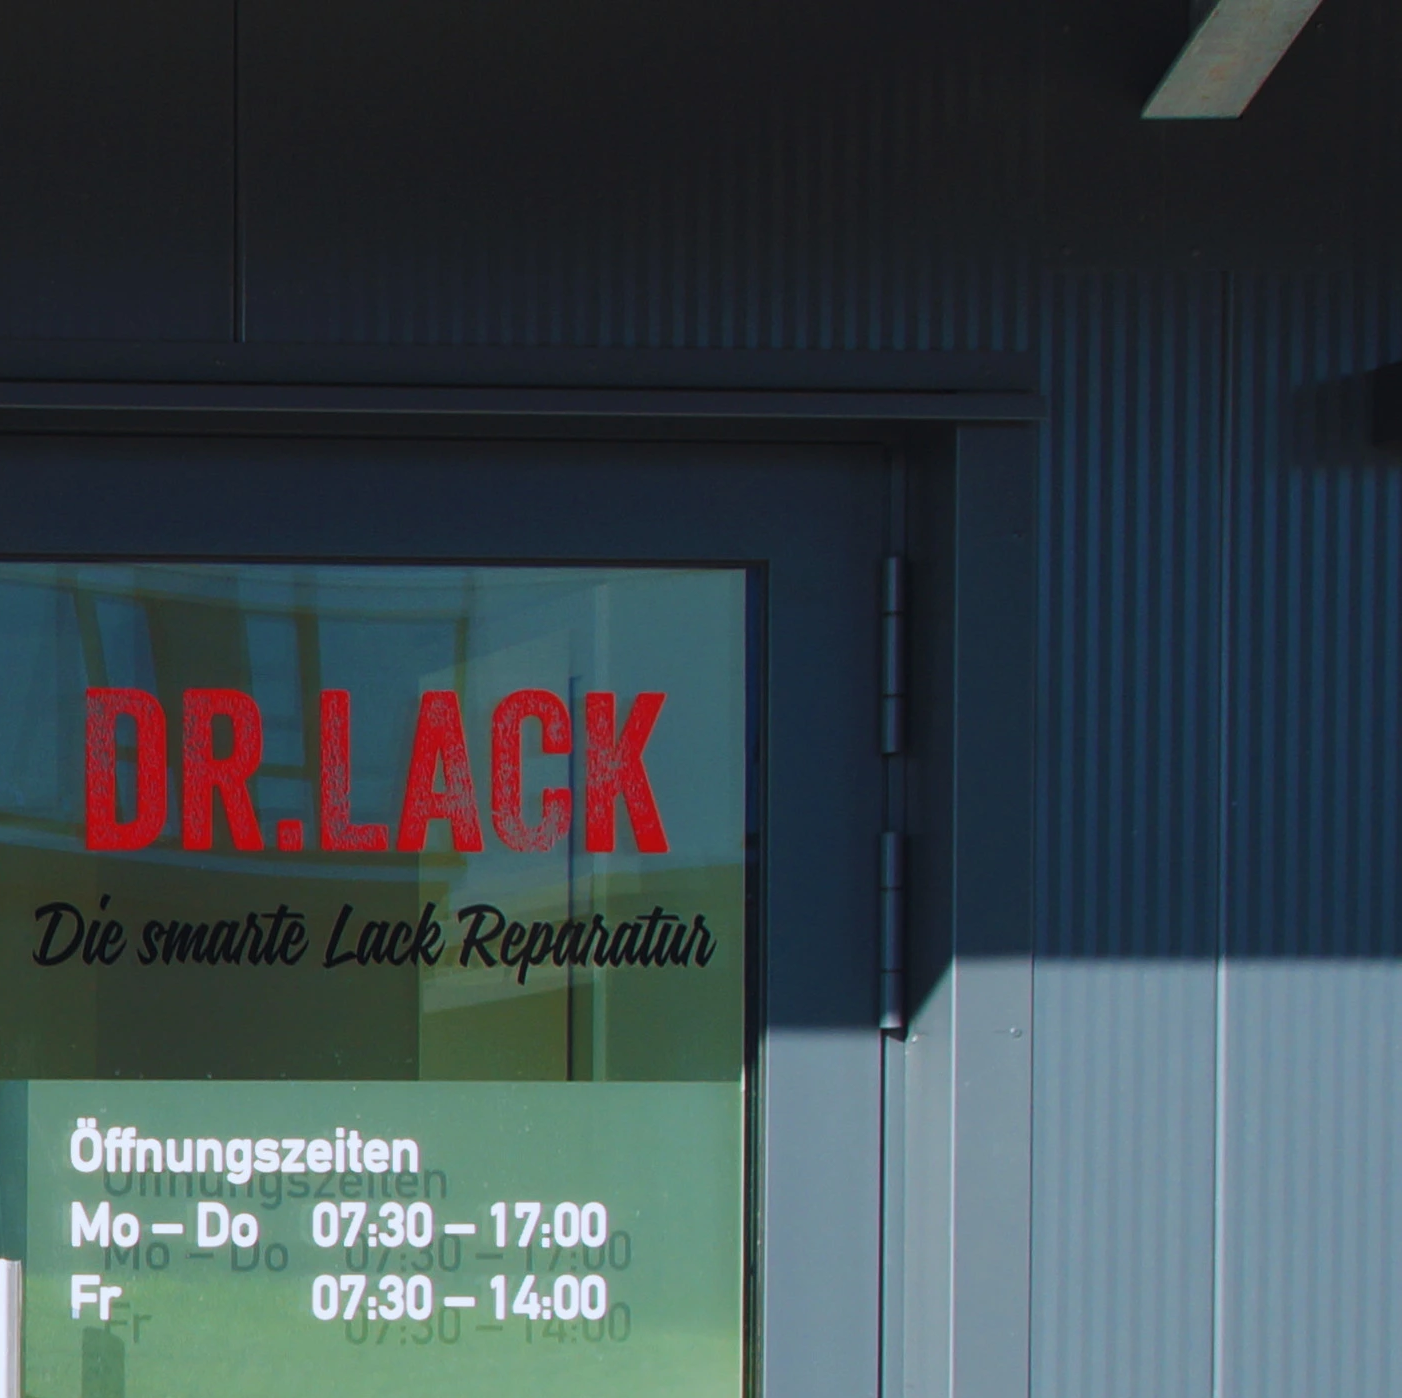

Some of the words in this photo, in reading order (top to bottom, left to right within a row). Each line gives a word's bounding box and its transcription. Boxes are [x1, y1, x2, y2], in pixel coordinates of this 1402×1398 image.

[85, 687, 670, 854] DR.LACK
[32, 893, 127, 966] Die
[137, 904, 310, 966] smarte
[322, 903, 446, 968] Lack
[457, 903, 718, 985] Reparatur
[70, 1117, 419, 1185] Öffnungszeiten
[70, 1201, 140, 1248] Mo
[196, 1201, 259, 1248] Do
[311, 1201, 433, 1248] 07:30
[489, 1201, 607, 1248] 17:00
[70, 1274, 122, 1320] Fr
[311, 1274, 433, 1321] 07:30
[489, 1274, 607, 1321] 14:00
